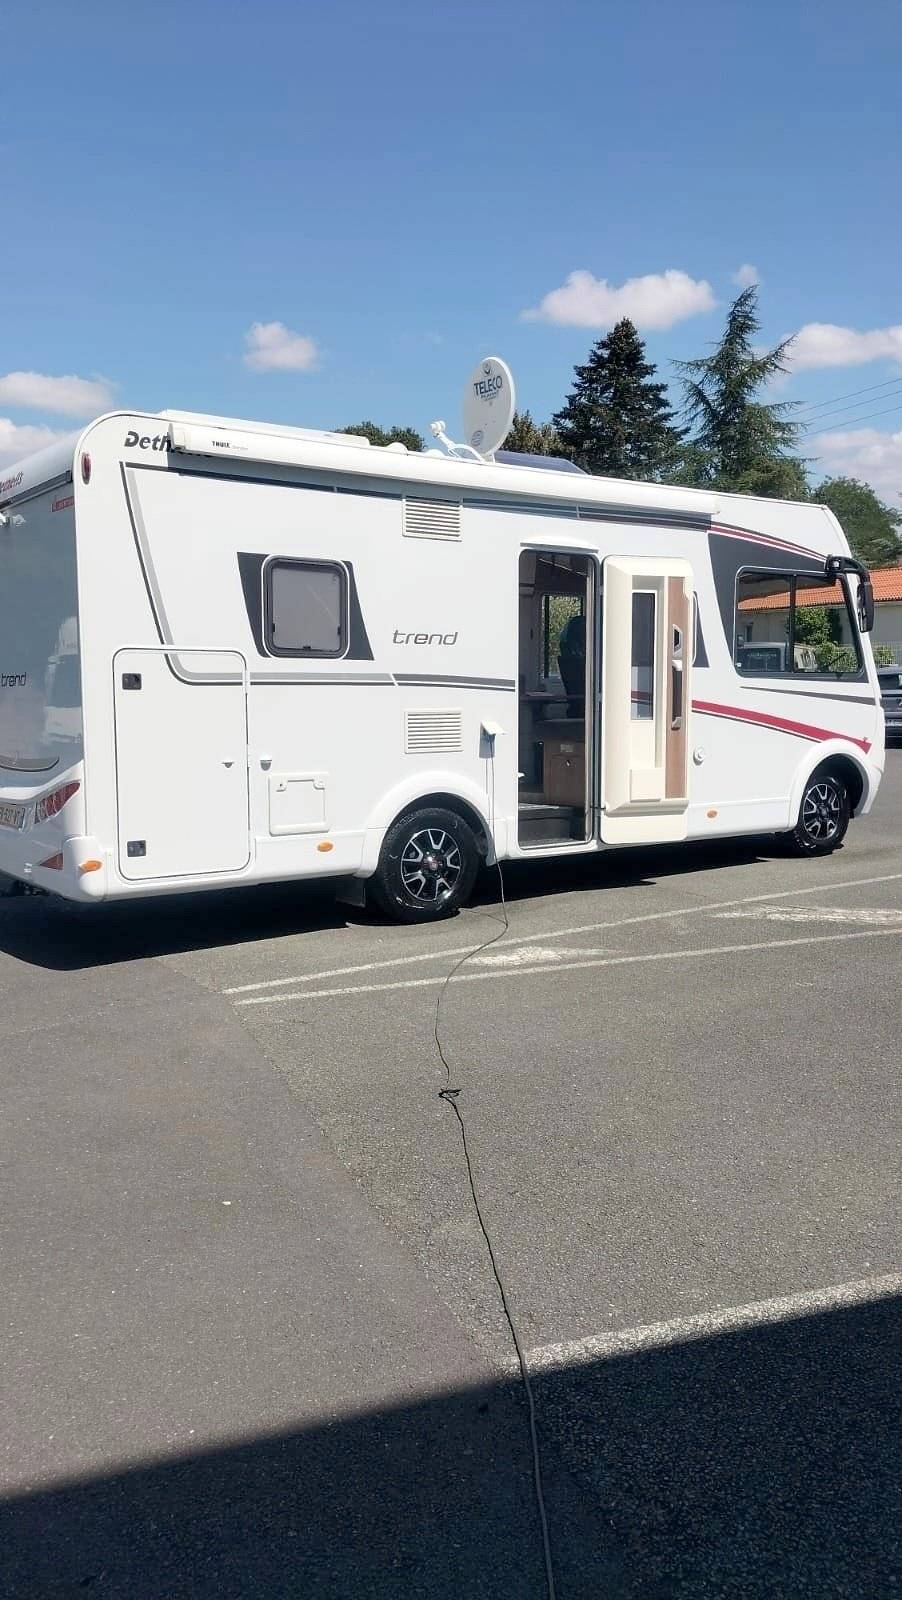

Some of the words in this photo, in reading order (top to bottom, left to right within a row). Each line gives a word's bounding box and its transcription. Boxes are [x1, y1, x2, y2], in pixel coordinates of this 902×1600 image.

[473, 375, 503, 396] TELECO
[392, 629, 459, 646] trend
[1, 671, 27, 687] trend
